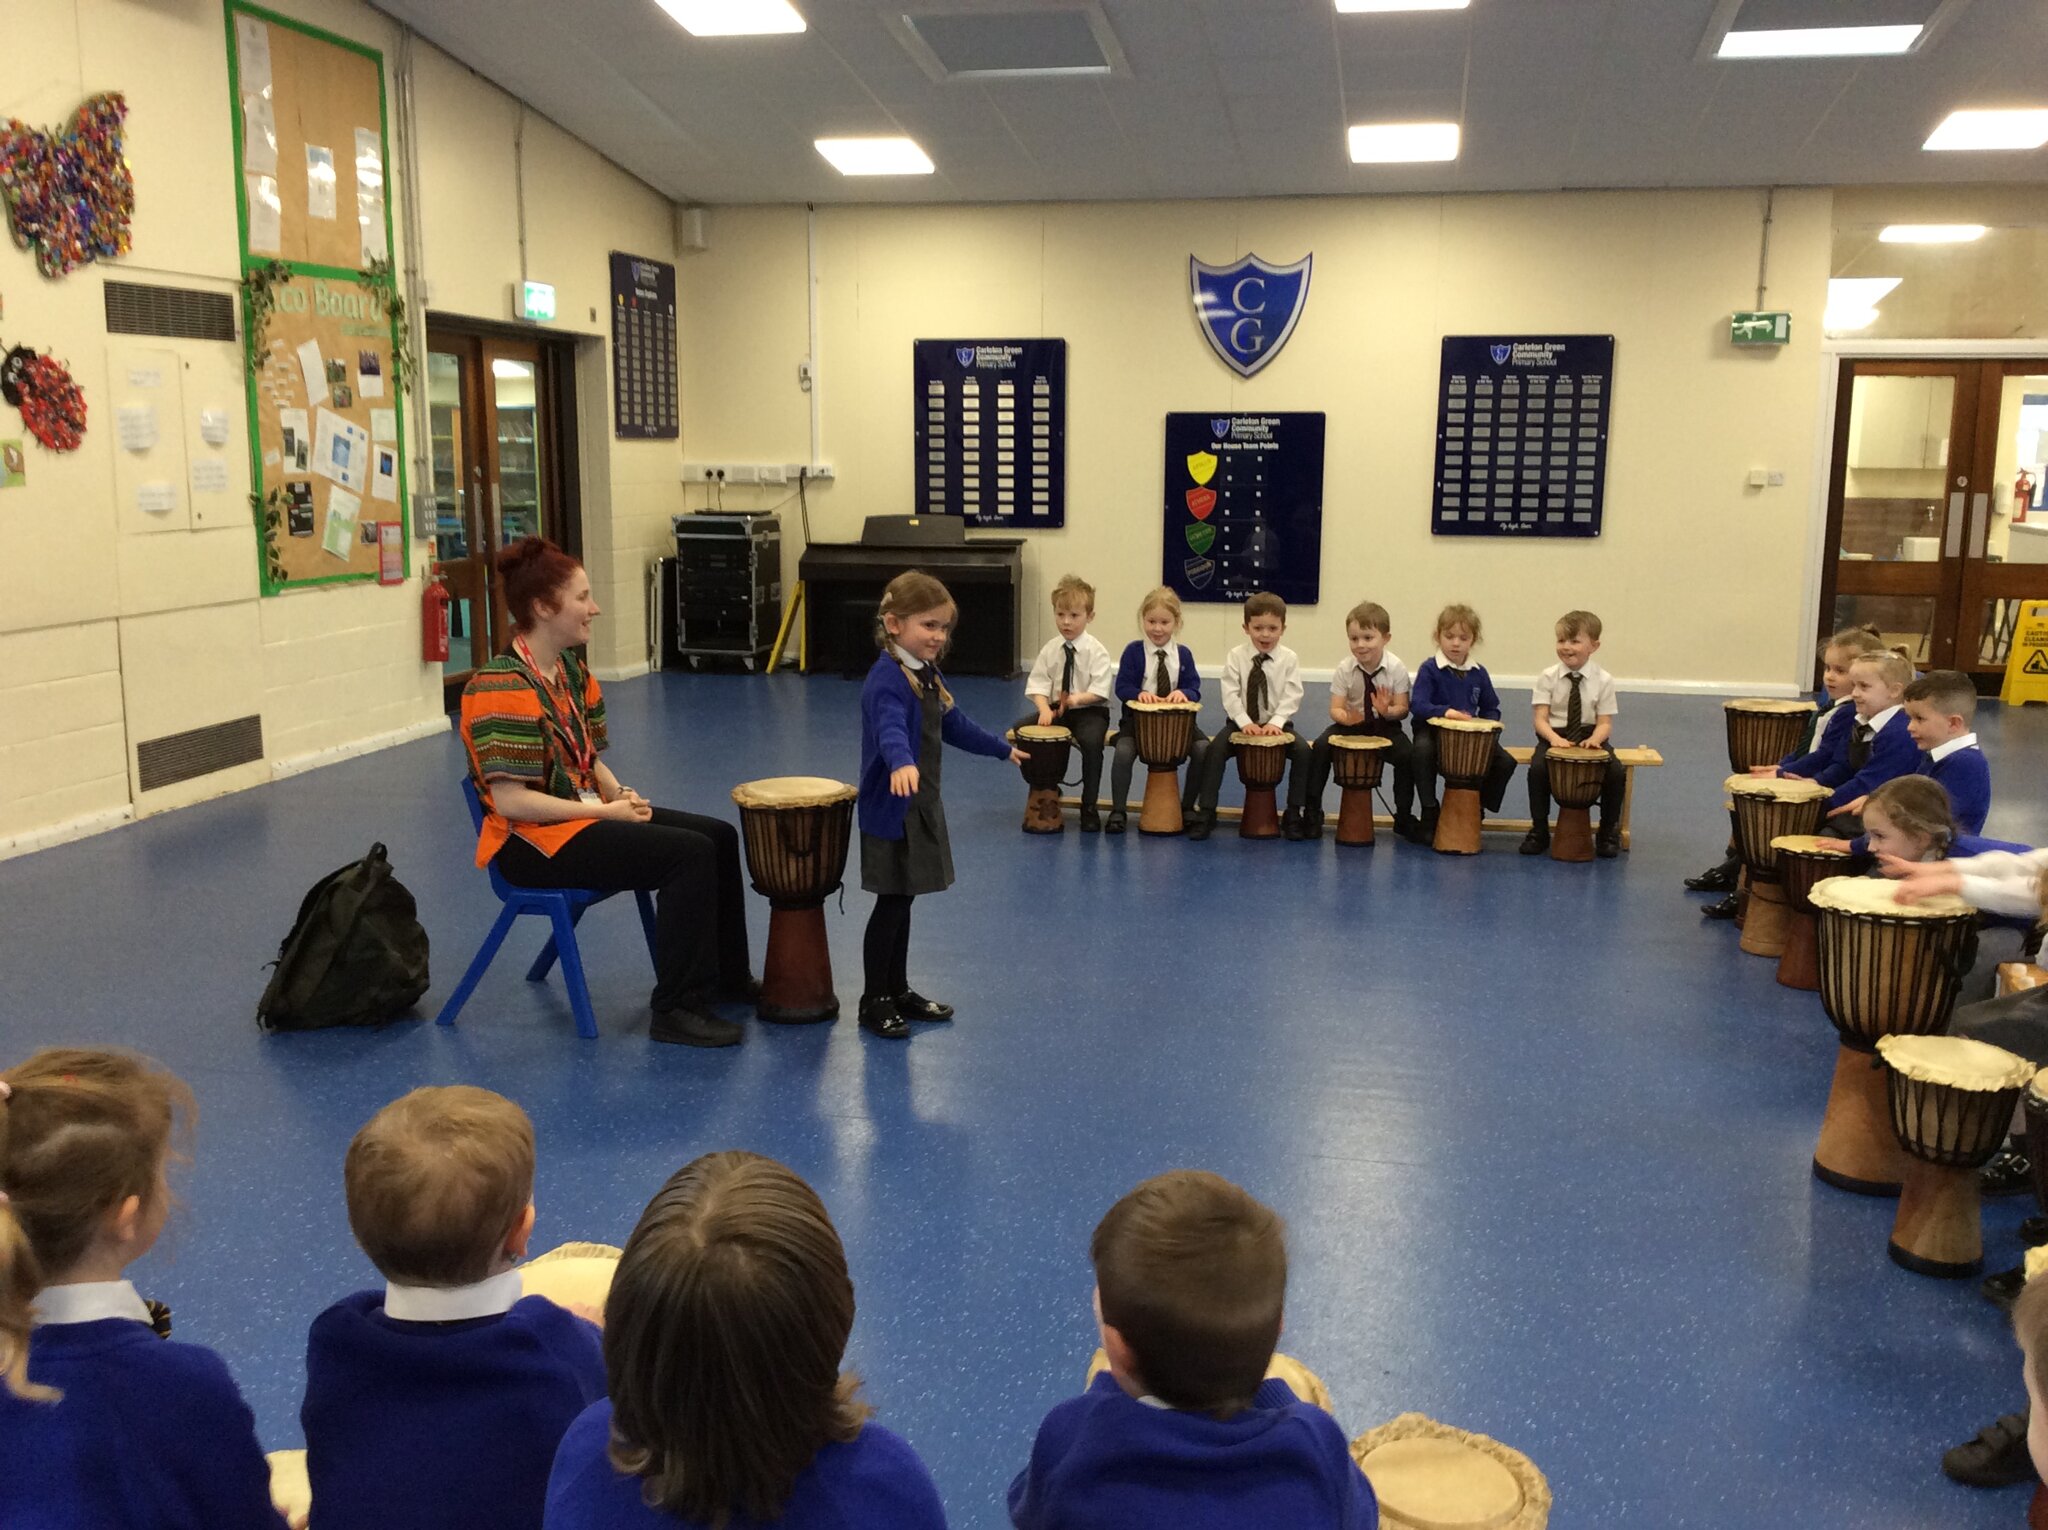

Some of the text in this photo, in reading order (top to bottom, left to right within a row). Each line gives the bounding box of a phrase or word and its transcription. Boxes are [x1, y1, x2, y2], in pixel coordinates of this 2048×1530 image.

[1232, 277, 1266, 314] C
[1230, 317, 1265, 353] G
[1004, 346, 1023, 354] Green
[1512, 342, 1566, 352] Carleton Green
[1512, 351, 1553, 359] Community
[1512, 359, 1535, 367] Primary
[1231, 417, 1280, 426] Carleton Green
[1231, 432, 1252, 440] Primary
